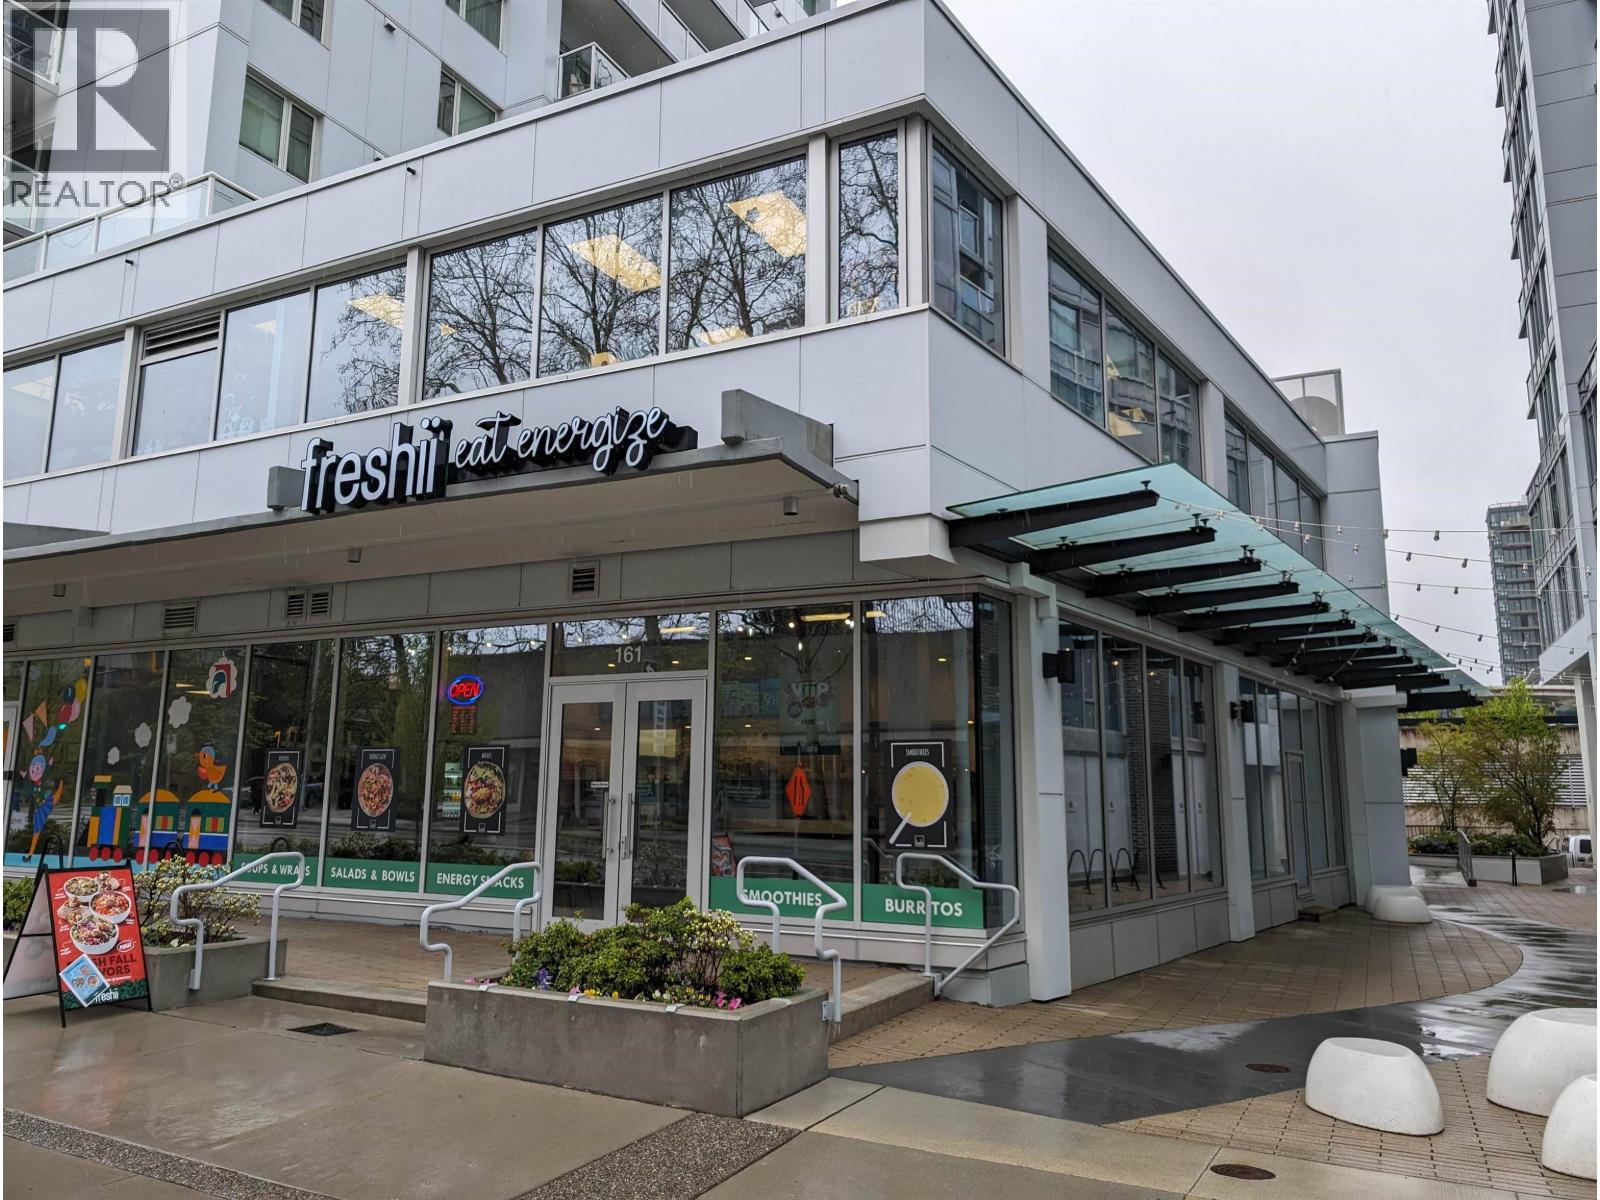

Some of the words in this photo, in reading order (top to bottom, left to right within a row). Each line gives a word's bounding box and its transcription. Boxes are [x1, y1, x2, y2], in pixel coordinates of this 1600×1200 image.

[455, 411, 520, 469] eat
[516, 405, 668, 472] energize
[615, 645, 642, 664] 161
[449, 681, 480, 698] OPEN
[271, 864, 277, 875] &
[279, 864, 311, 876] WRAS
[331, 866, 367, 880] SALADS
[370, 869, 377, 880] &
[381, 869, 415, 883] BOWLS
[436, 872, 478, 886] ENERGY
[884, 898, 963, 917] BURRTOS
[109, 953, 137, 965] FALL
